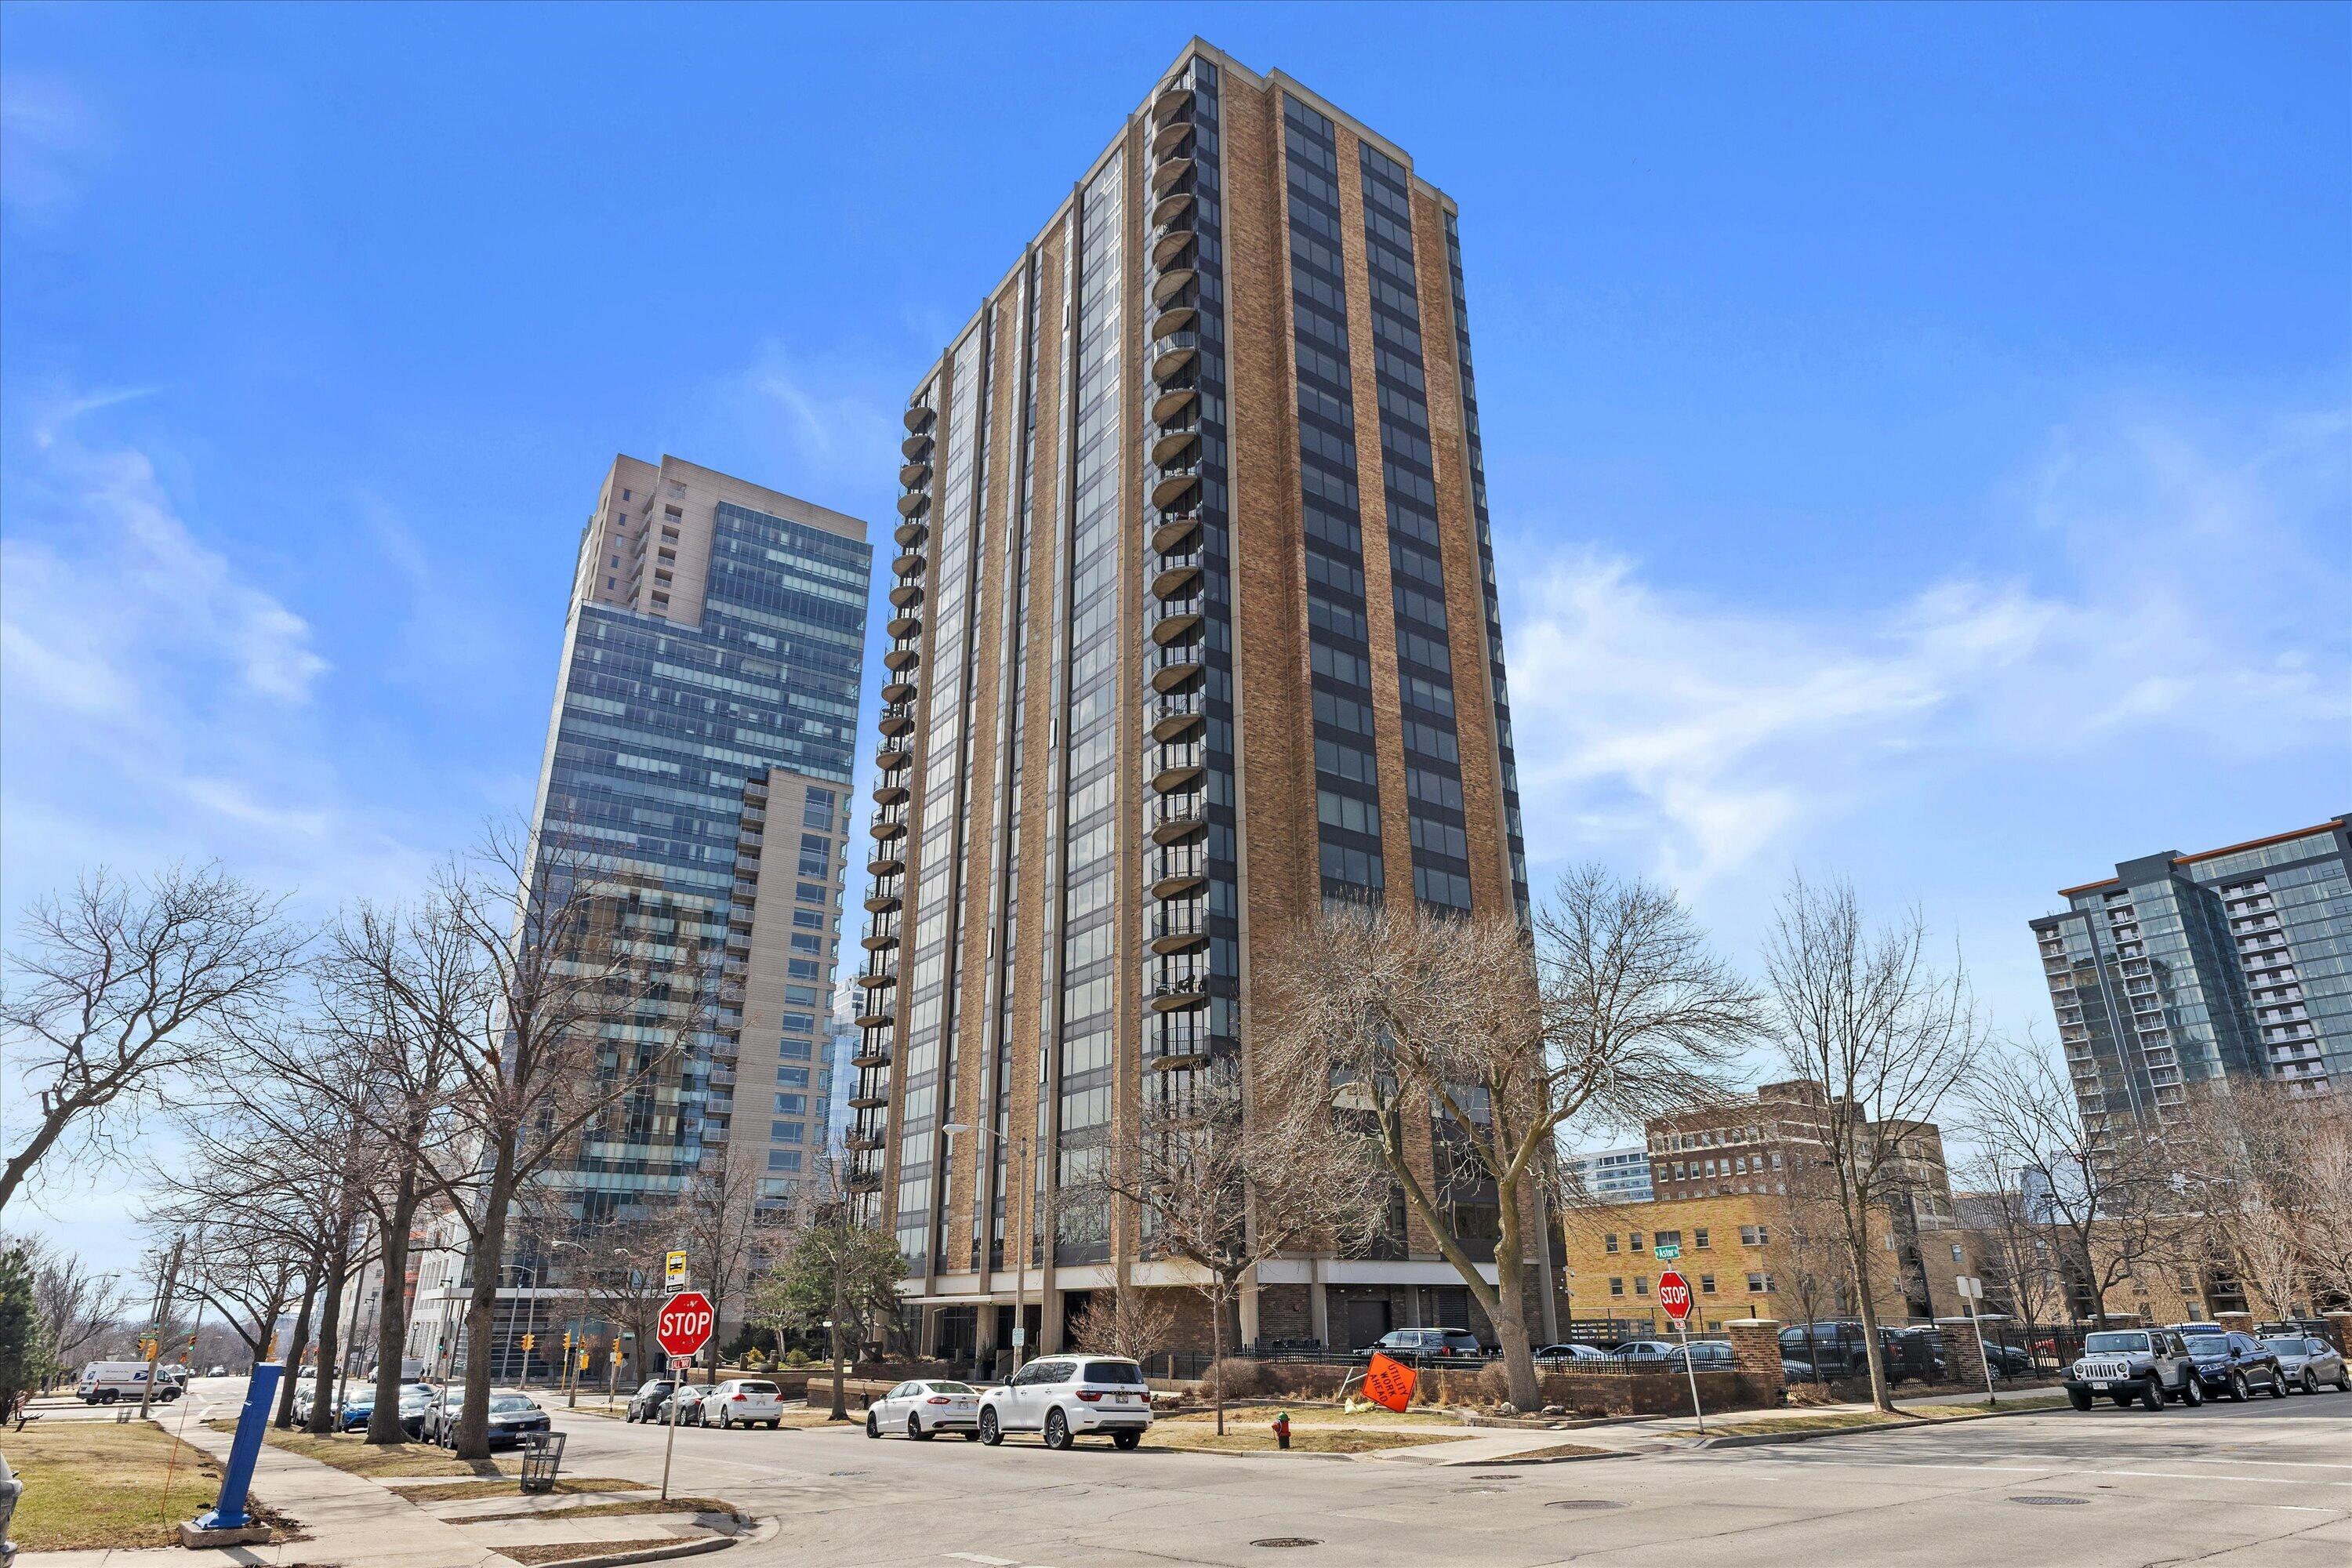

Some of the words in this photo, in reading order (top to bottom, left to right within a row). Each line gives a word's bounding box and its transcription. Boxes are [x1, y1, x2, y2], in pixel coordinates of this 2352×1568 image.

[1659, 1249, 1674, 1258] Astor
[1661, 1286, 1686, 1305] STOP
[661, 1312, 710, 1337] STOP
[1370, 1374, 1388, 1403] AHEAD
[1381, 1371, 1397, 1397] WORK
[1388, 1363, 1409, 1396] UTILITY
